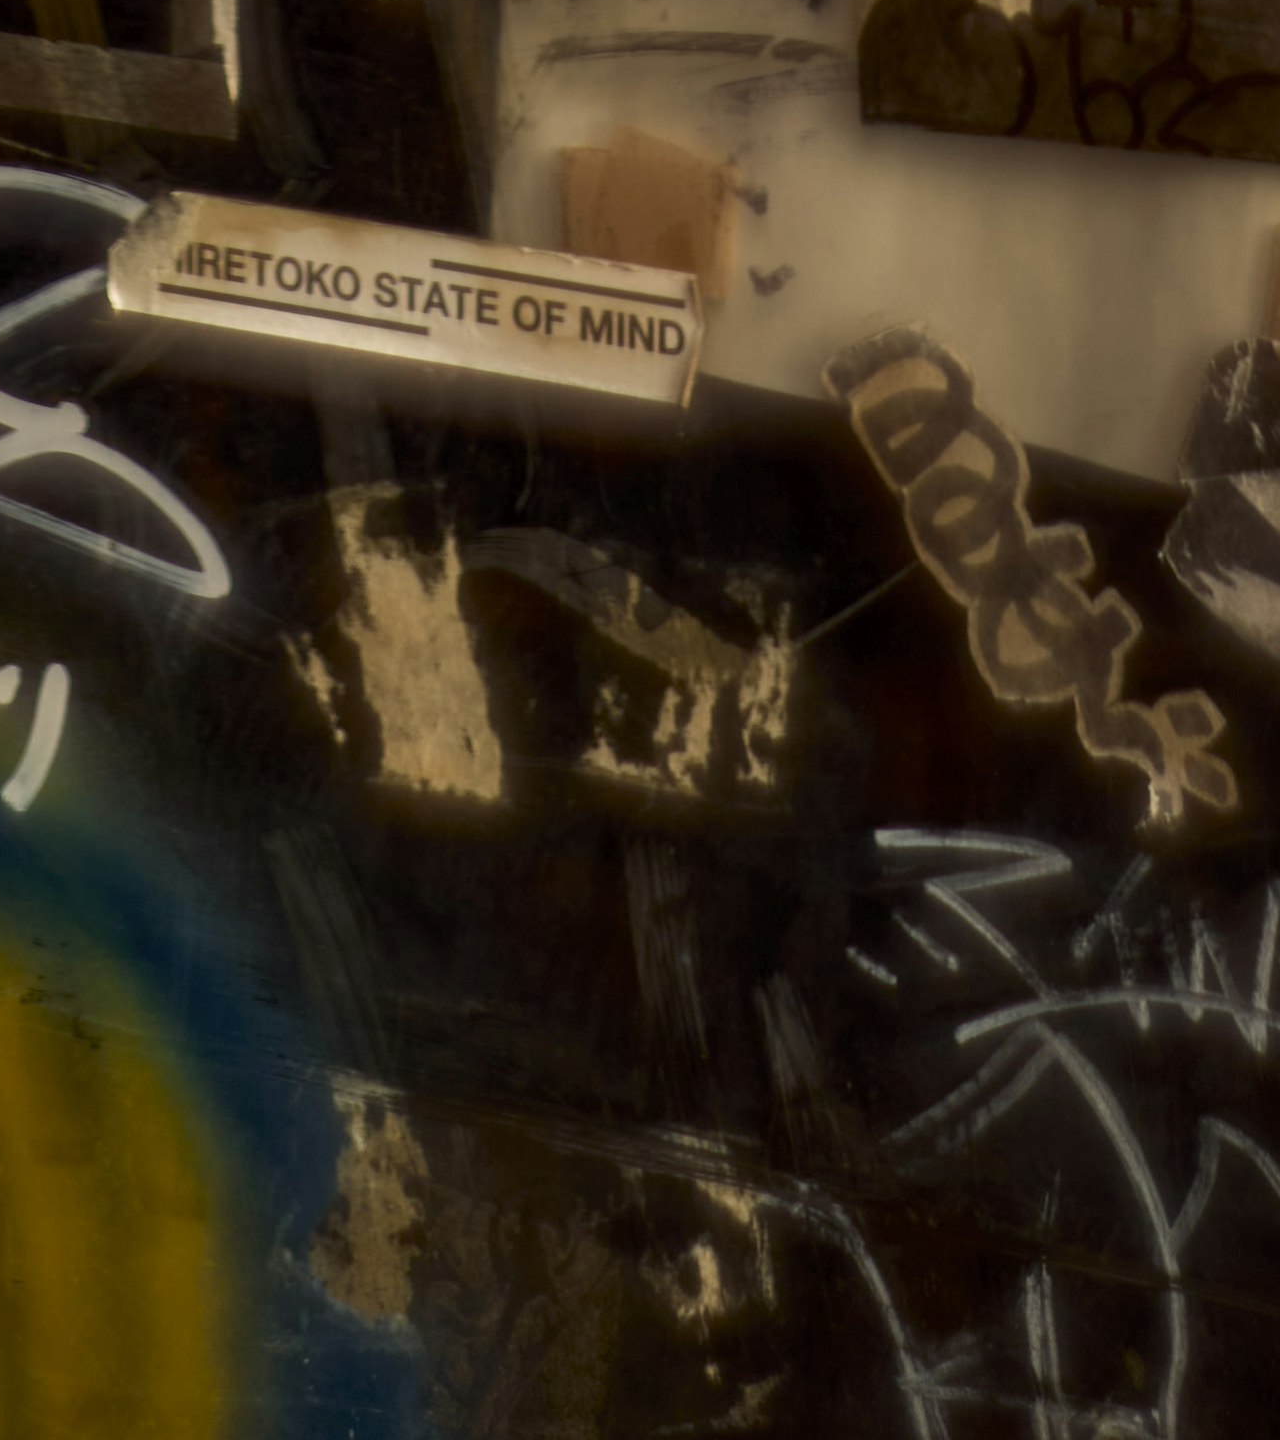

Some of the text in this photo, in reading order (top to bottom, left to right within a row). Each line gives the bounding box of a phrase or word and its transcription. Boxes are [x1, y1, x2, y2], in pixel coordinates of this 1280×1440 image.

[373, 270, 500, 327] STATE
[511, 296, 566, 335] OF
[579, 306, 687, 357] MIND
